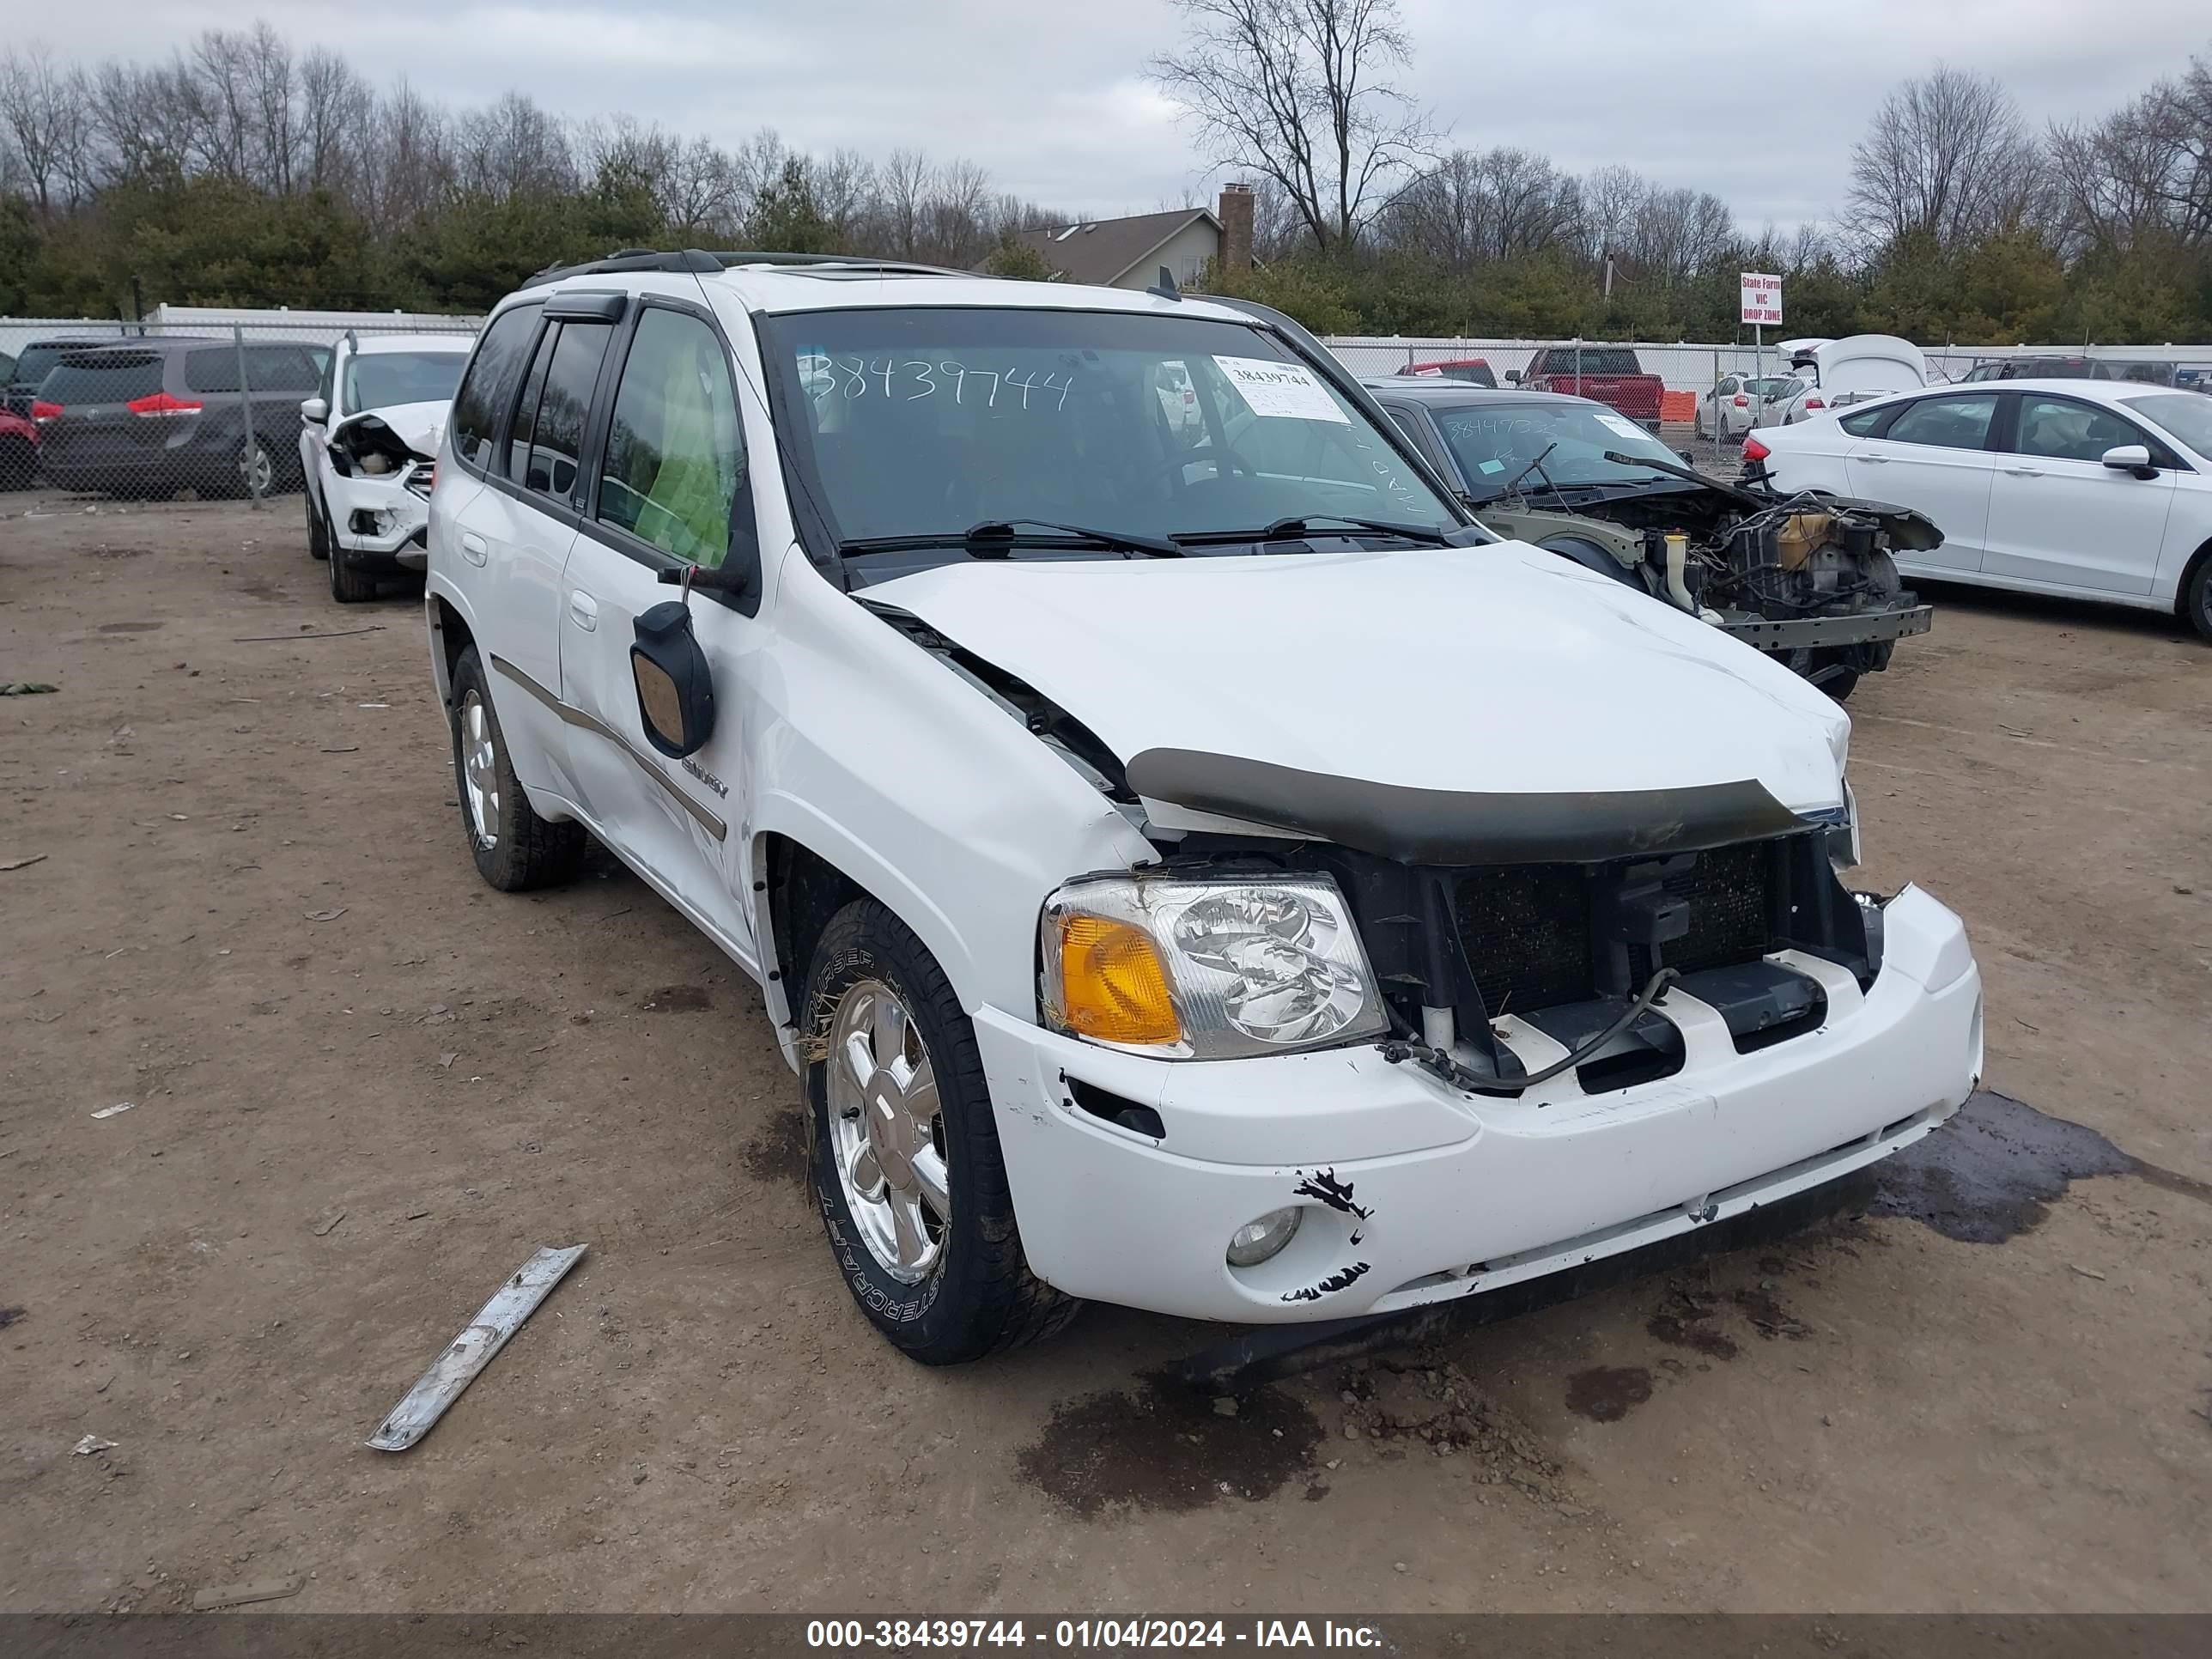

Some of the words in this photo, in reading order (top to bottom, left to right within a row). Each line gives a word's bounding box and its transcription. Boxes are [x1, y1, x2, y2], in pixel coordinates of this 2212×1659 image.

[1742, 276, 1761, 289] State
[1763, 278, 1780, 289] Farm
[1755, 293, 1768, 305] VIC
[1743, 308, 1763, 320] DROP
[1764, 309, 1781, 321] ZONE
[797, 355, 1073, 411] 38439744
[1232, 369, 1312, 387] 38439744
